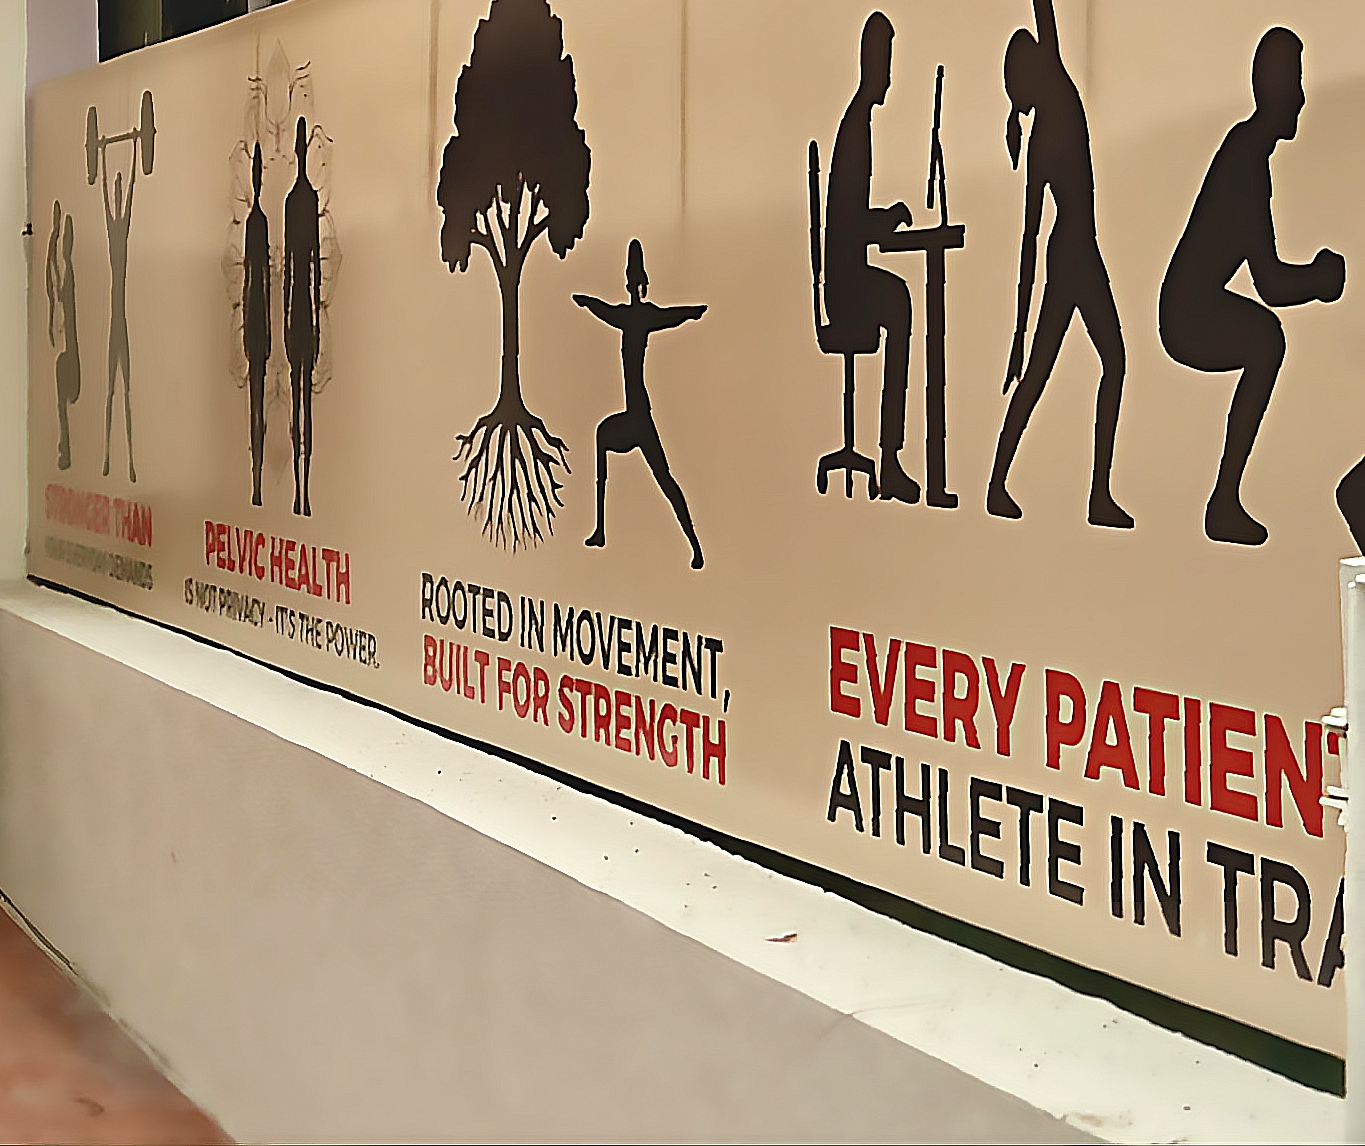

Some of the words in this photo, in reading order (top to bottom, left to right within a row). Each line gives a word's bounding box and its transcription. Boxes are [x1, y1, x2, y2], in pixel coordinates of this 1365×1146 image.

[204, 520, 266, 581] PELVIC
[270, 536, 351, 605] HEALTH
[299, 612, 322, 649] THE
[326, 621, 380, 669] POWER.
[421, 572, 513, 642] ROOTED
[520, 596, 545, 653] IN
[553, 602, 731, 713] MOVEMENT,
[830, 626, 1026, 757] EVERY
[424, 634, 490, 704] BUILT
[497, 656, 550, 727] FOR
[558, 674, 726, 785] STRENGTH
[827, 739, 1084, 907] ATHLETE
[1110, 815, 1182, 938] IN
